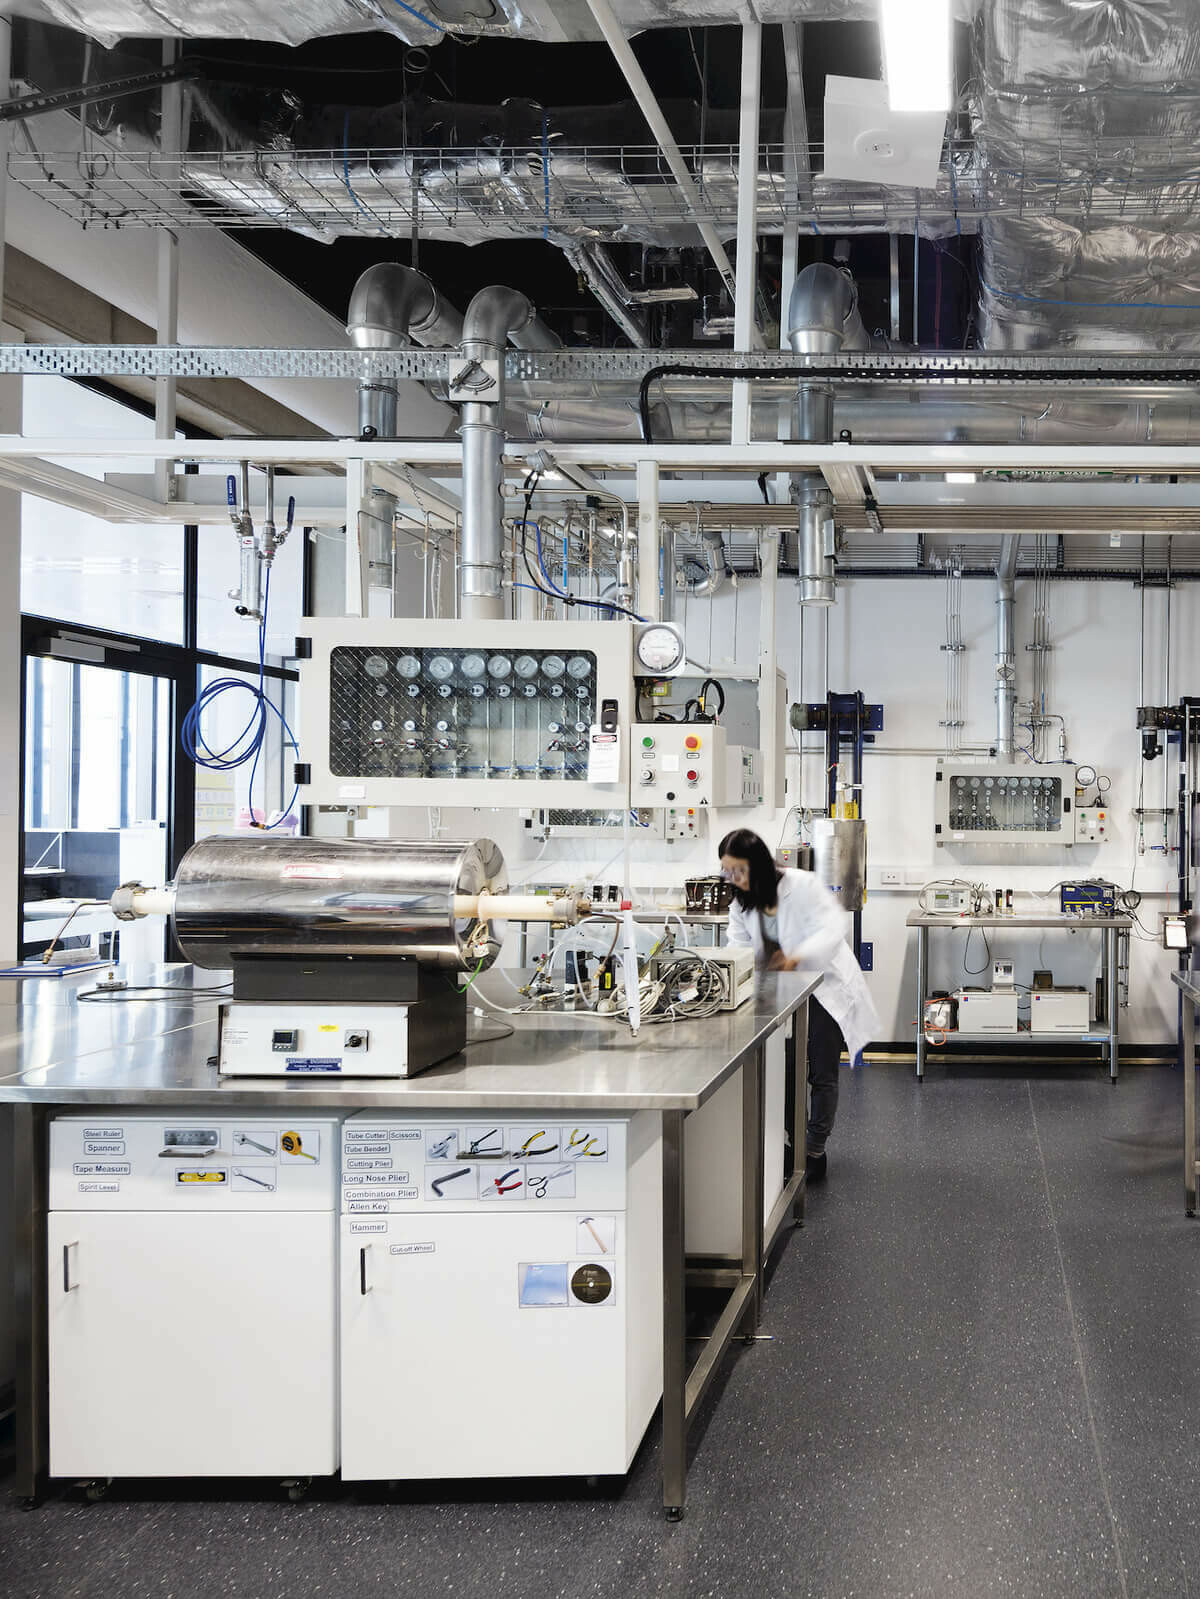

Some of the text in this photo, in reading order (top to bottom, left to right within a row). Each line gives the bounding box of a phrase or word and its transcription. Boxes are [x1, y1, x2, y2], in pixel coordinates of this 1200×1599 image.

[85, 1130, 101, 1138] Steel
[87, 1144, 121, 1152] Spanner
[75, 1165, 128, 1173] Tape Measure
[349, 1161, 373, 1169] Cutting
[344, 1175, 364, 1184] Long
[80, 1183, 98, 1191] Spirit
[346, 1190, 396, 1198] Combination
[371, 1202, 387, 1211] Key
